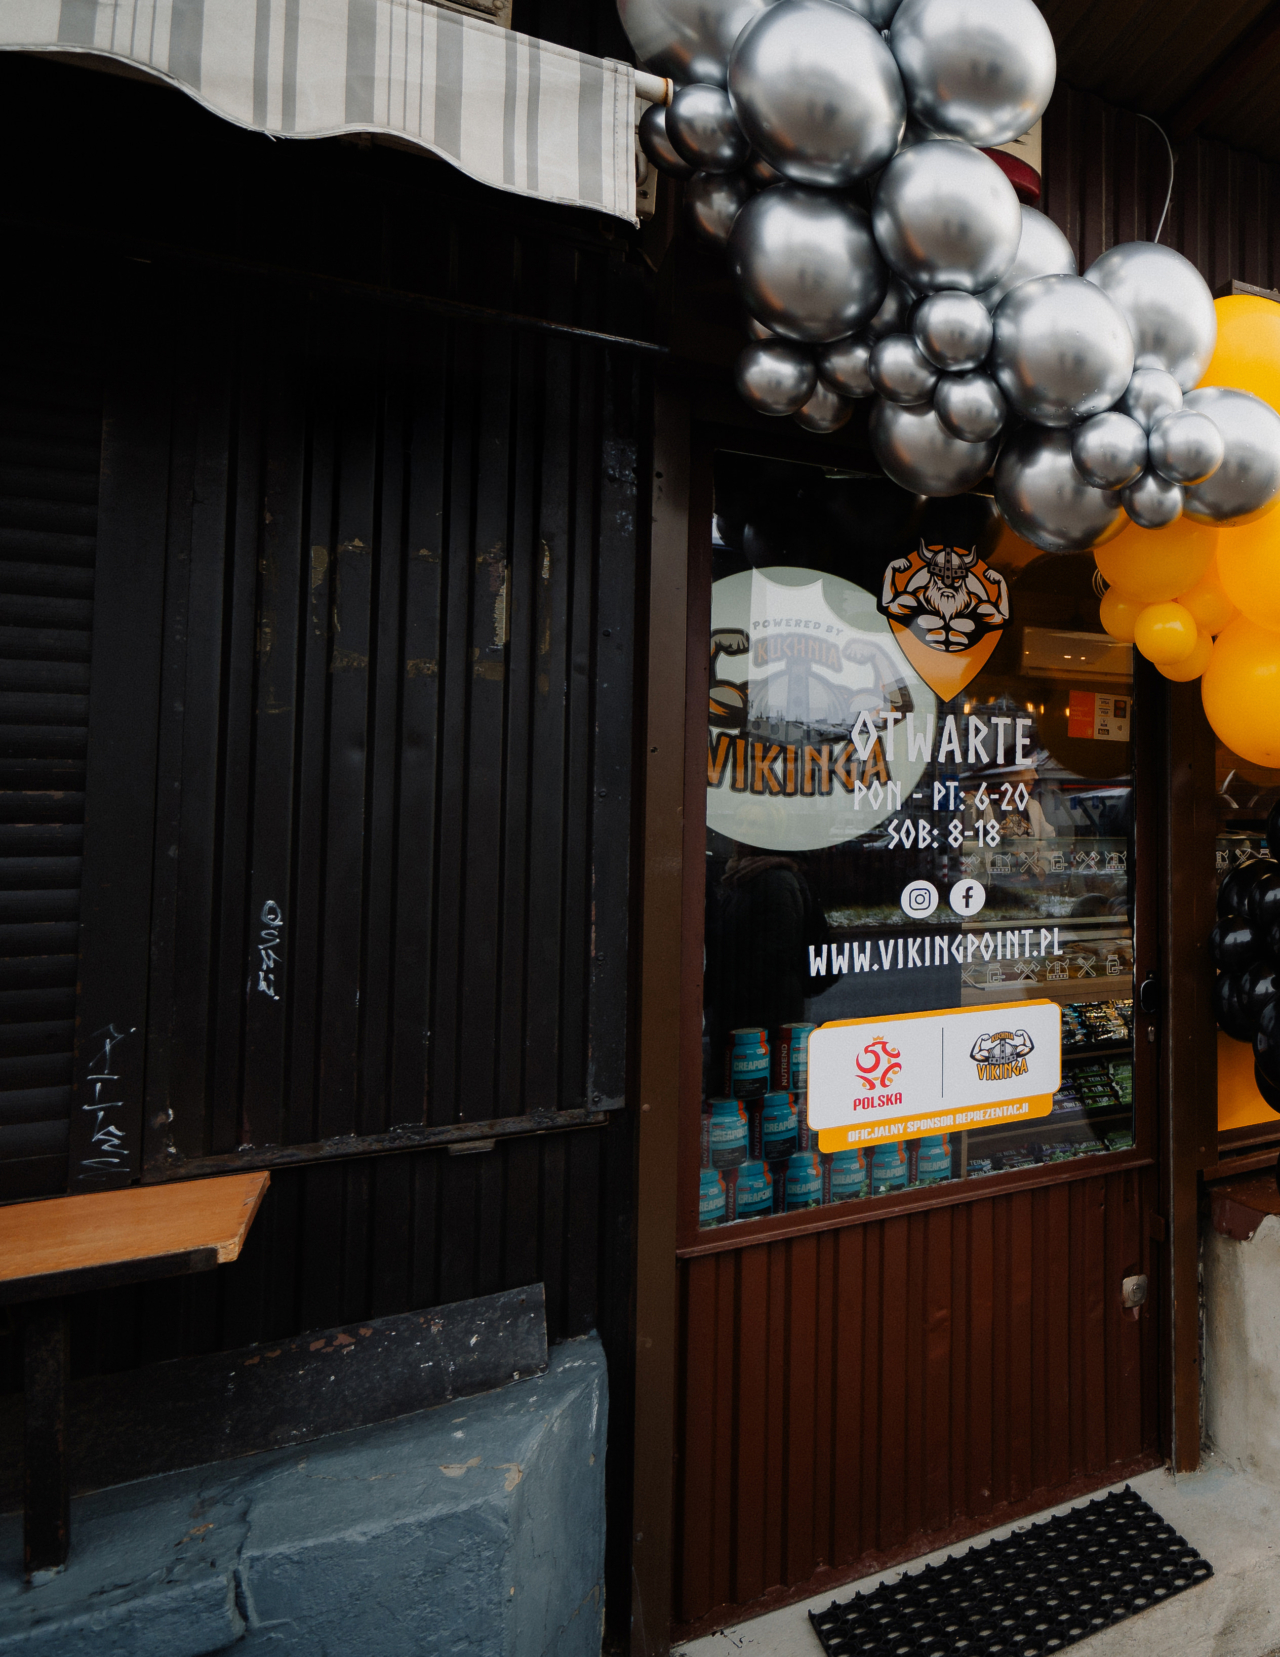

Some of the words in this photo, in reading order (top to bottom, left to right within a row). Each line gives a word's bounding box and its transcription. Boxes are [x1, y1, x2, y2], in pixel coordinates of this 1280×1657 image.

[752, 618, 822, 631] POWERED
[825, 624, 844, 636] BY
[757, 637, 839, 669] KUCHNIA
[851, 710, 1033, 765] OTWARTE
[707, 735, 890, 797] VIKINGA
[854, 780, 901, 811] PON
[933, 781, 966, 811] PT:
[975, 782, 1029, 811] 6-20
[888, 818, 939, 850] SOB:
[948, 819, 1000, 849] 8-18
[808, 927, 1064, 977] WWW.VIKINGPOINT.PL
[733, 1058, 769, 1071] CREAPORT
[976, 1058, 1028, 1080] VIKINGA
[853, 1092, 903, 1111] POLSKA
[847, 1123, 905, 1142] OFICJALNY
[907, 1115, 954, 1133] SPONSOR
[955, 1102, 1029, 1125] REPREZENTACJI
